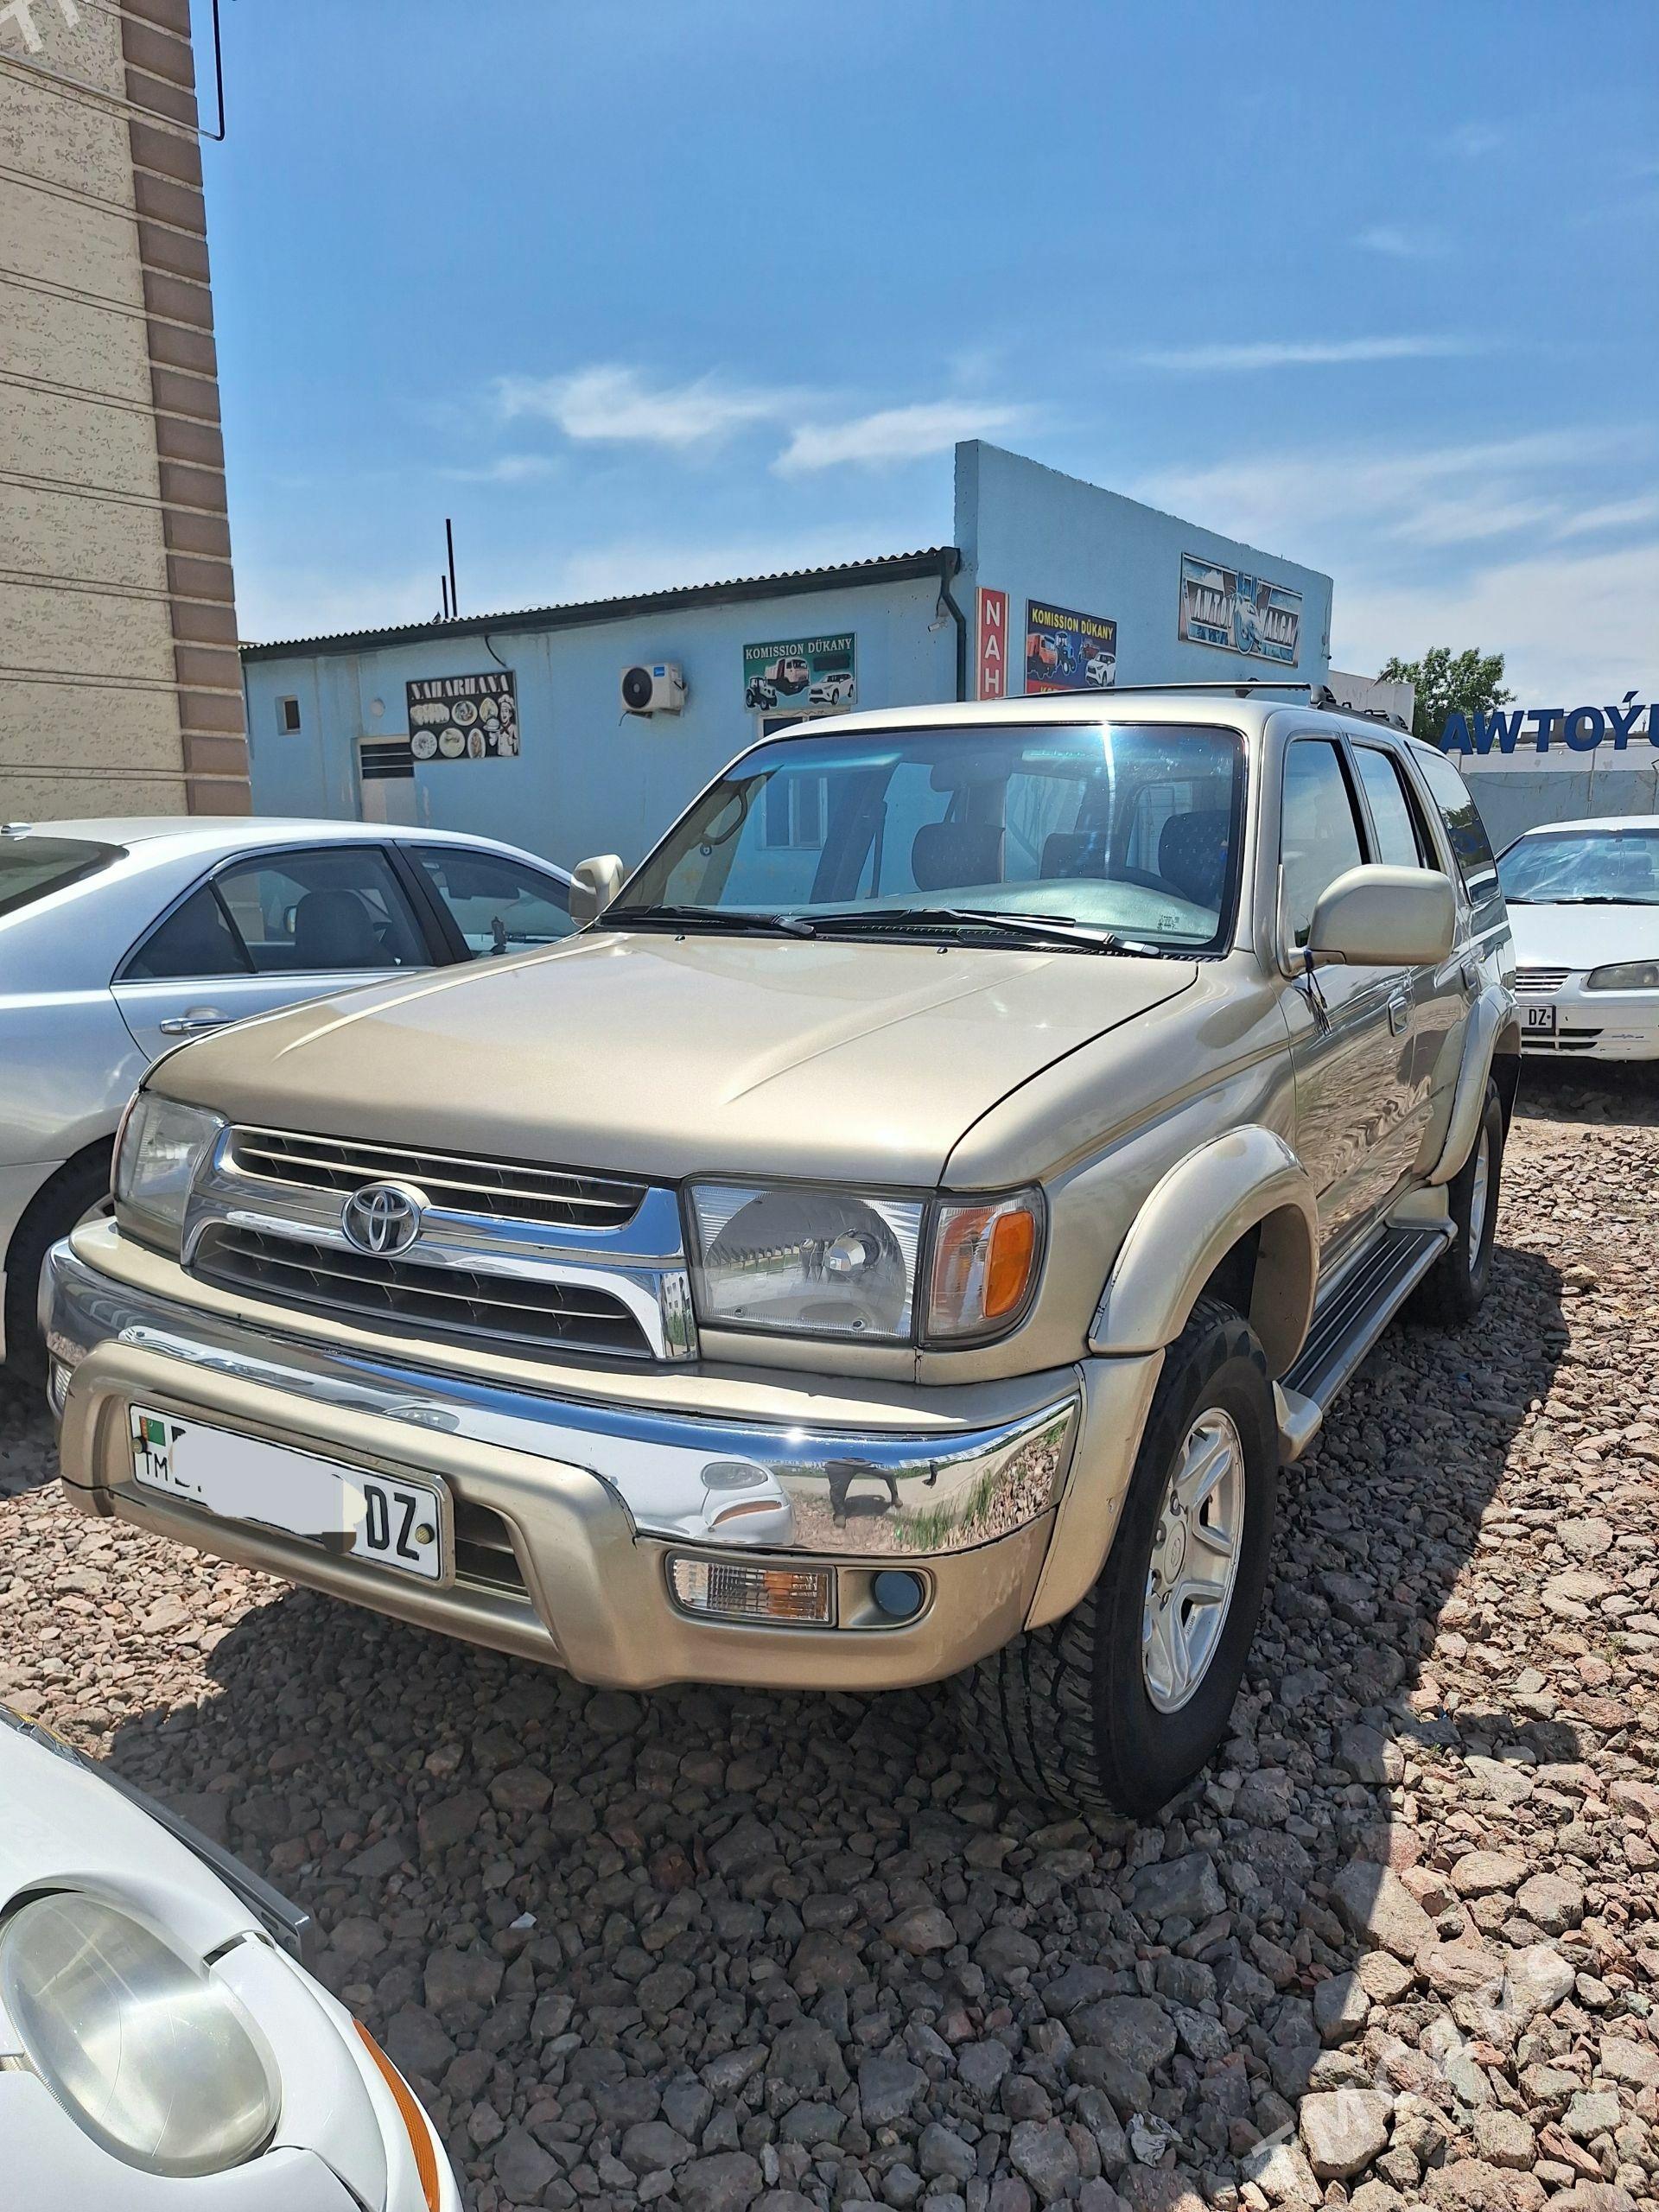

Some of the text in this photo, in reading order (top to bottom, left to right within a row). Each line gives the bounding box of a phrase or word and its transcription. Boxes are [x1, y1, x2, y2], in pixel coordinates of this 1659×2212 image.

[1032, 607, 1114, 641] KOMISSION DÜKANY
[746, 638, 852, 660] KOMISSION DÜKANY
[1529, 1008, 1547, 1026] DZ
[143, 1452, 168, 1482] TM
[364, 1484, 420, 1561] DZ
